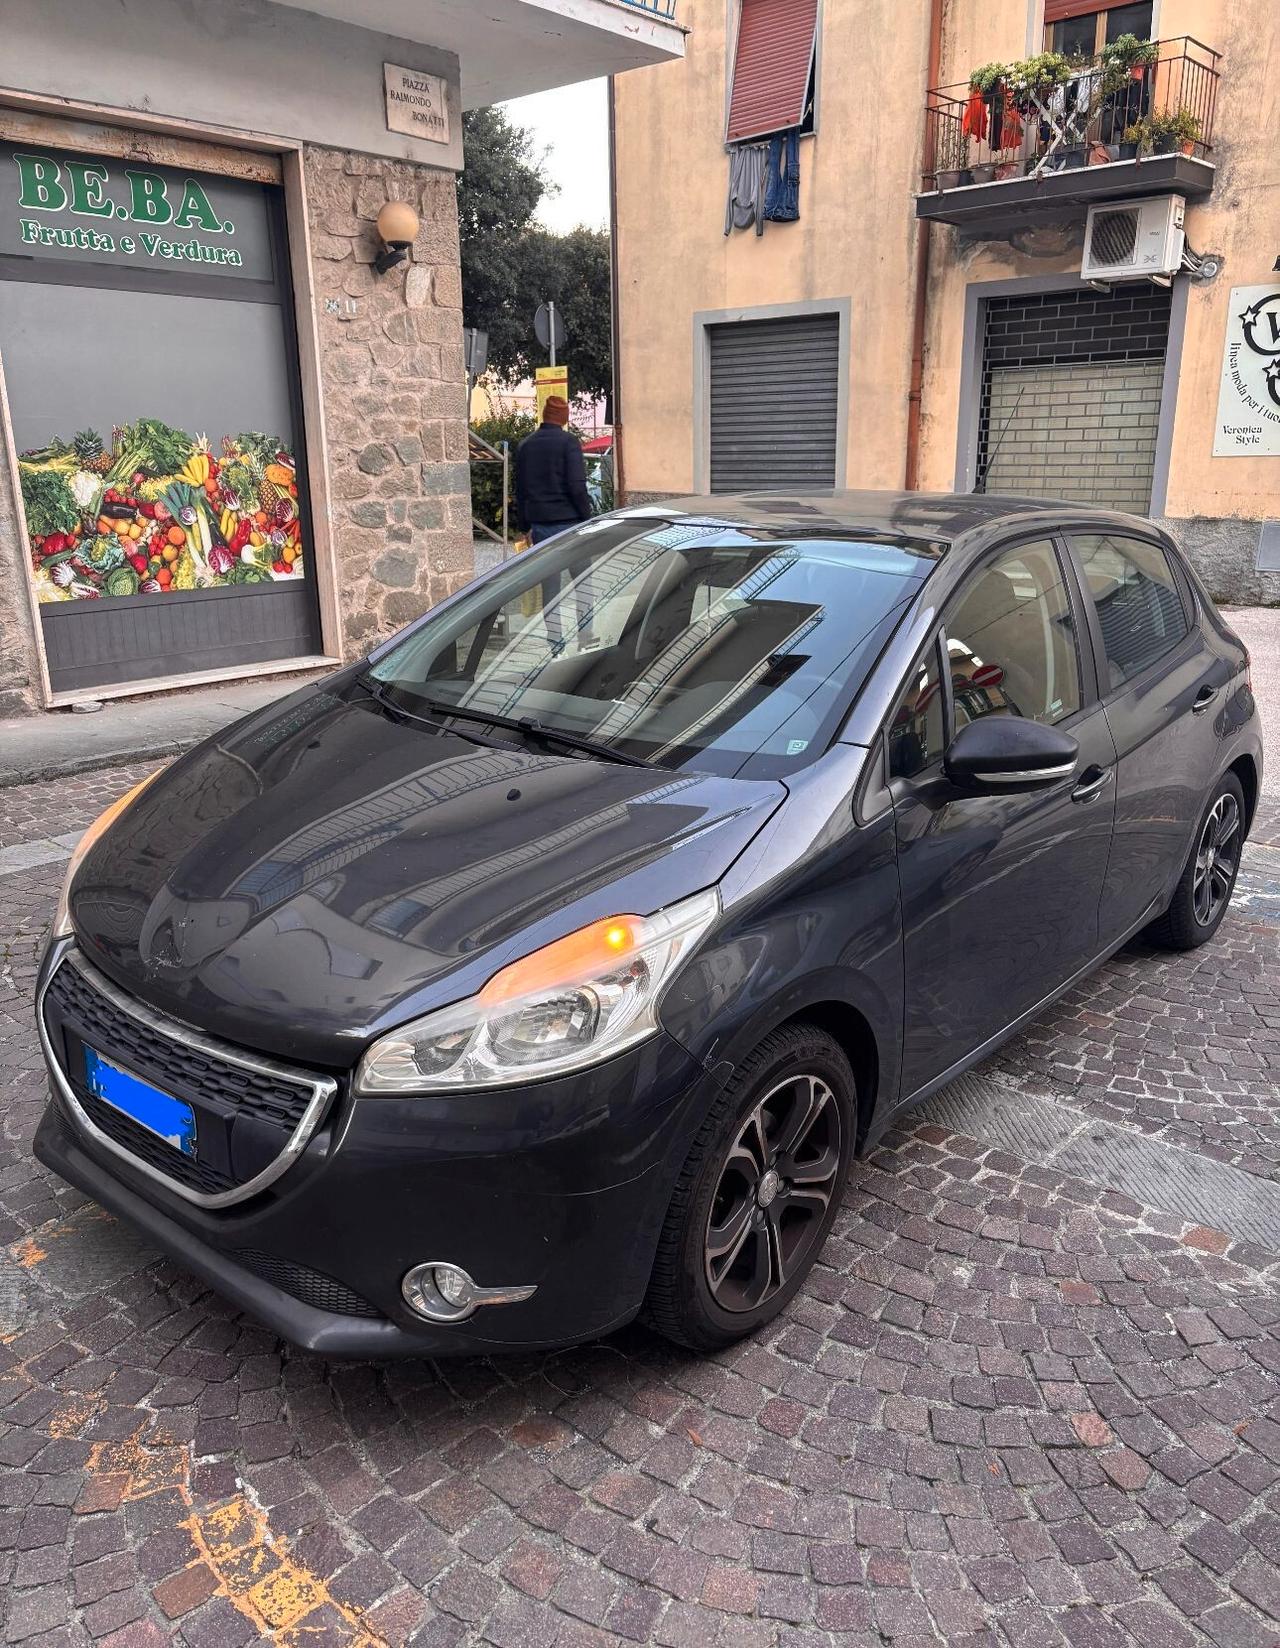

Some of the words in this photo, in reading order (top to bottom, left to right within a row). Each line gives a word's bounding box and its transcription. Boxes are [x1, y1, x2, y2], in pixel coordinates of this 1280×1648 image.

[402, 77, 430, 93] PIAZZA
[390, 90, 432, 108] RAIMONDO
[412, 111, 445, 129] BONATTI
[13, 153, 235, 235] BE.BA.
[19, 218, 116, 252] Frutta
[120, 236, 136, 253] e
[139, 233, 243, 266] Verdura
[1229, 342, 1242, 369] linea
[1231, 370, 1248, 396] moda
[1241, 394, 1259, 410] per
[1257, 405, 1265, 414] i
[1263, 408, 1280, 423] tuo
[1223, 425, 1262, 435] Veronica
[1235, 435, 1260, 446] Style
